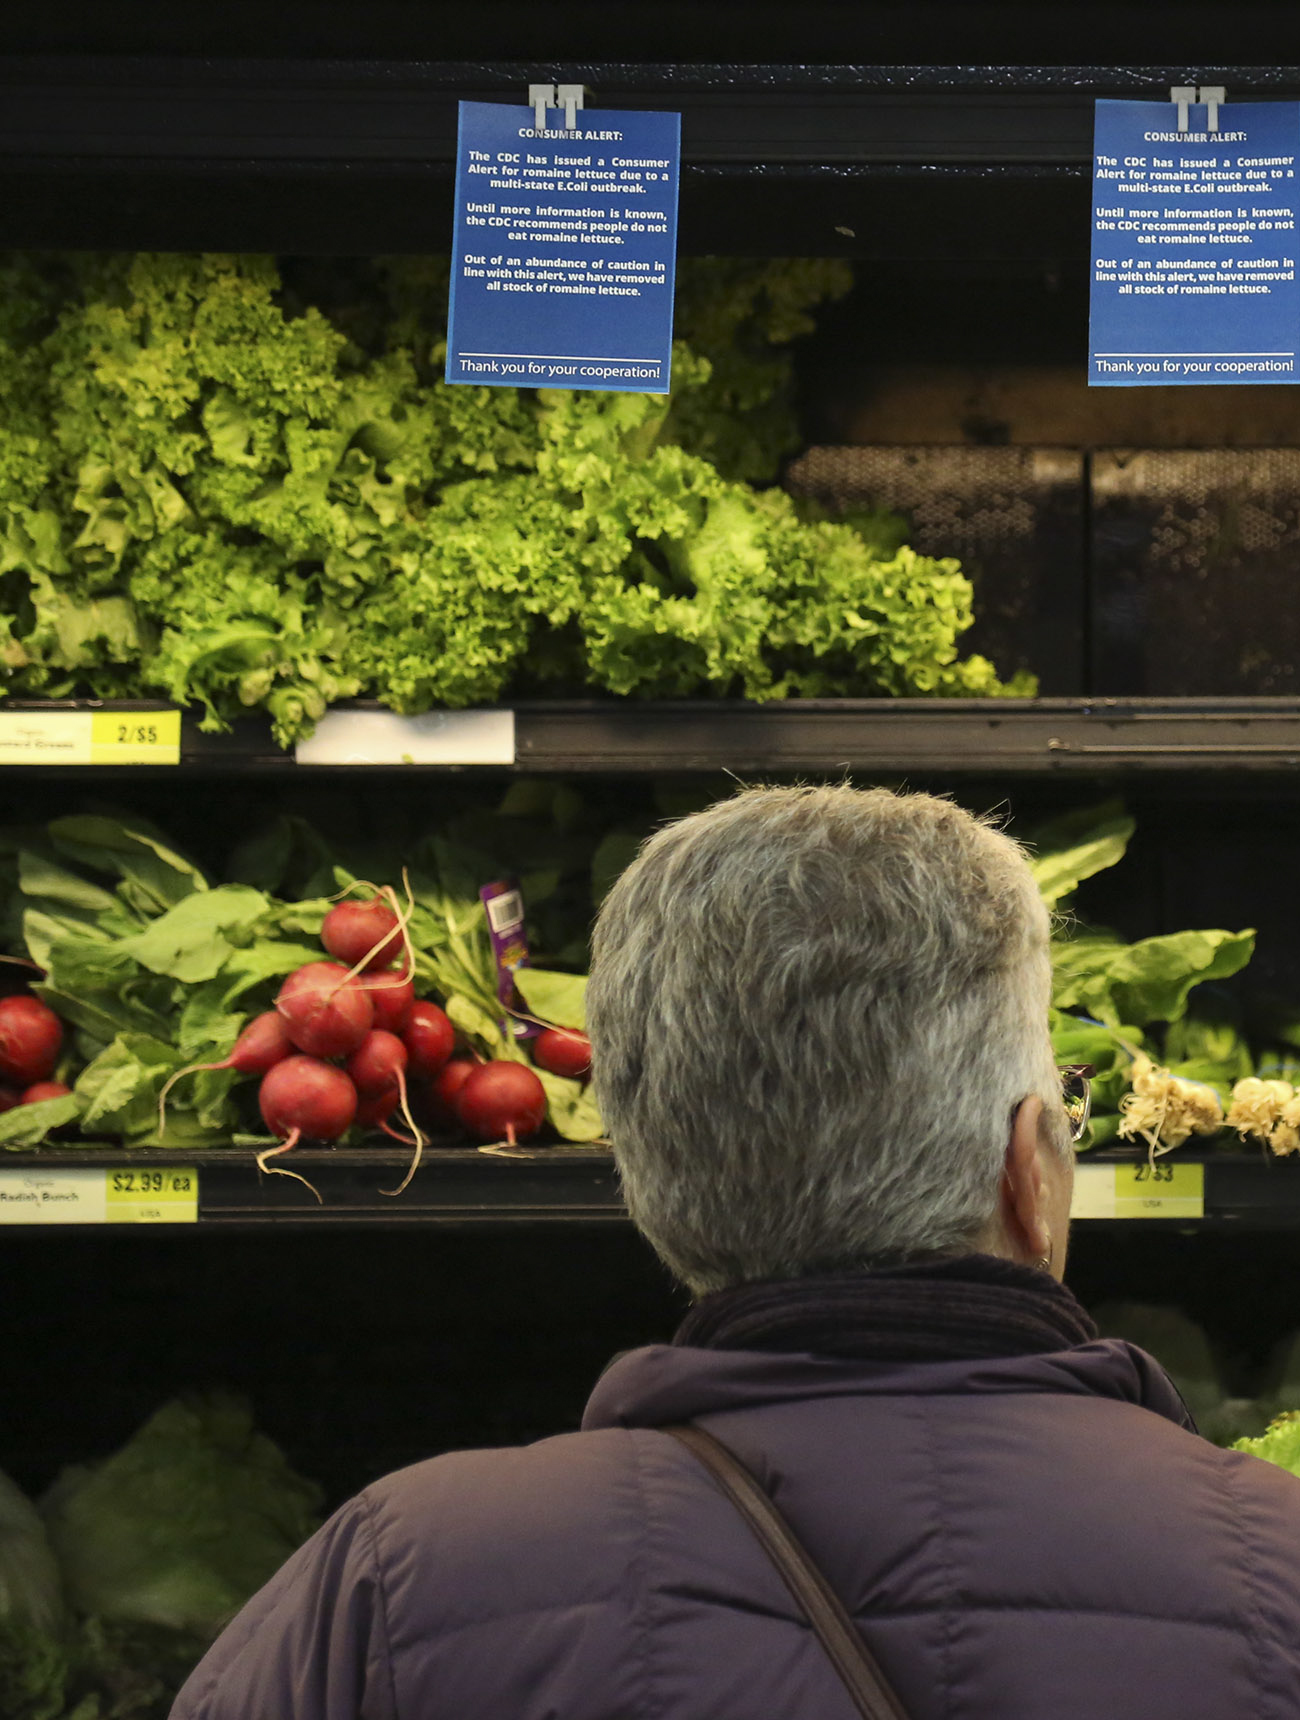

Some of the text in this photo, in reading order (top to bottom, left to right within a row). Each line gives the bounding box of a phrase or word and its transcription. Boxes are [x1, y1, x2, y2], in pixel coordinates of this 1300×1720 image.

[519, 128, 622, 140] CONSUMER ALERT:
[1144, 131, 1247, 142] CONSUMER ALERT:
[469, 151, 490, 161] The
[497, 153, 520, 163] CDC
[527, 154, 547, 164] has
[554, 155, 591, 165] issued
[612, 157, 670, 167] Consumer
[1097, 156, 1117, 166] The
[1124, 157, 1146, 167] CDC
[1153, 158, 1173, 167] has
[1180, 158, 1216, 168] issued
[1237, 157, 1294, 167] Consumer
[468, 164, 497, 174] Alert
[502, 166, 519, 175] for
[523, 168, 571, 178] romaine
[575, 169, 616, 179] lettuce
[620, 170, 641, 180] due
[646, 172, 657, 180] to
[1096, 169, 1125, 179] Alert
[1129, 170, 1146, 179] for
[1150, 171, 1197, 180] romaine
[1202, 171, 1241, 180] lettuce
[1246, 170, 1267, 179] due
[1271, 170, 1283, 178] to
[490, 178, 646, 193] multi-state E.Coli outbreak.
[1118, 182, 1272, 193] multi-state E.Coli outbreak.
[467, 203, 667, 221] Until more information is known,
[1096, 208, 1293, 218] Until more information is known,
[466, 216, 667, 233] the CDC recommends people do not
[1096, 220, 1294, 233] the CDC recommends people do not
[508, 232, 624, 244] eat romaine lettuce.
[1137, 233, 1252, 243] eat romaine lettuce.
[465, 255, 486, 264] Out
[490, 256, 502, 265] of
[526, 257, 587, 268] abundance
[592, 259, 603, 269] of
[608, 260, 649, 270] caution
[655, 261, 665, 271] in
[1096, 259, 1117, 268] Out
[1121, 259, 1133, 268] of
[1156, 259, 1216, 269] abundance
[1221, 259, 1233, 268] of
[1237, 258, 1278, 268] caution
[1283, 258, 1294, 267] in
[464, 267, 665, 284] line with this alert, we have removed
[1096, 271, 1116, 281] line
[1118, 271, 1143, 281] with
[1145, 272, 1166, 281] this
[1167, 272, 1197, 282] alert,
[1217, 272, 1243, 281] have
[1245, 270, 1294, 280] removed
[487, 281, 641, 296] all stock of romaine lettuce.
[1119, 284, 1271, 294] all stock of romaine lettuce.
[460, 360, 660, 379] Thank you for your cooperation!
[1096, 360, 1293, 374] Thank you for your cooperation!
[118, 725, 157, 743] 2/$5
[113, 1173, 191, 1192] $2.99/ea
